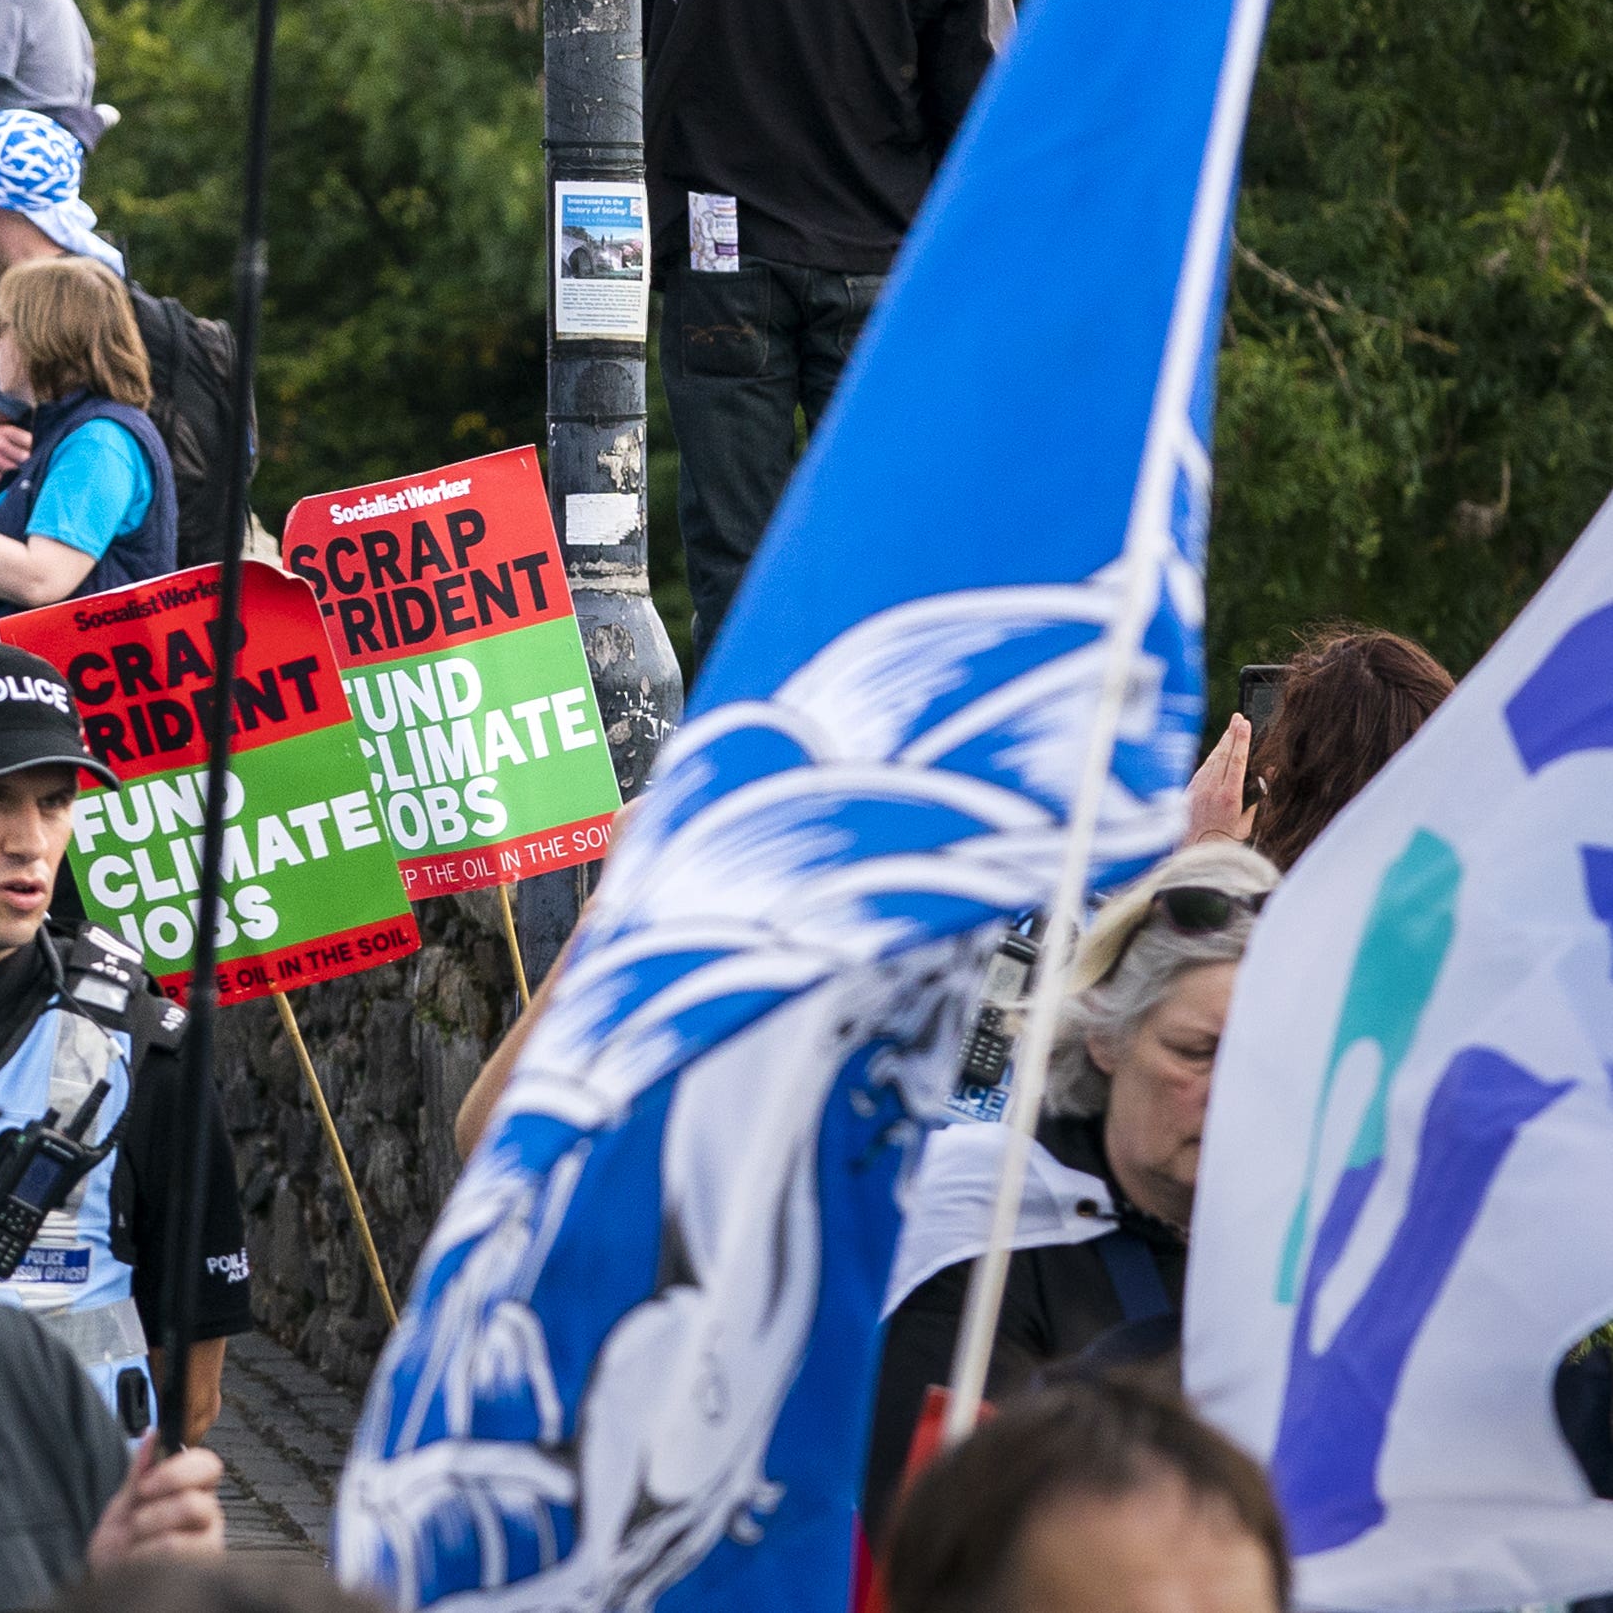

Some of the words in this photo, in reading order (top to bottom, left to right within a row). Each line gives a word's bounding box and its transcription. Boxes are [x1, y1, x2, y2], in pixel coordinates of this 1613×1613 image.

[329, 491, 407, 525] Socialist
[404, 478, 472, 510] Worker
[290, 509, 486, 601] SCRAP
[74, 599, 162, 632] Socialist
[158, 579, 222, 615] Worke
[67, 619, 248, 706] CRAP
[342, 657, 483, 733] UND
[83, 655, 320, 768] RIDENT
[73, 769, 246, 855] FUND
[88, 789, 382, 909] CLIMATE
[376, 775, 509, 851] OBS
[423, 862, 460, 886] THE
[462, 856, 496, 881] OIL
[498, 848, 522, 873] IN
[523, 836, 568, 864] THE
[236, 965, 272, 988] OIL
[277, 956, 302, 980] IN
[305, 942, 354, 971] THE
[356, 926, 411, 956] SOIL
[25, 1249, 67, 1266] POLICE
